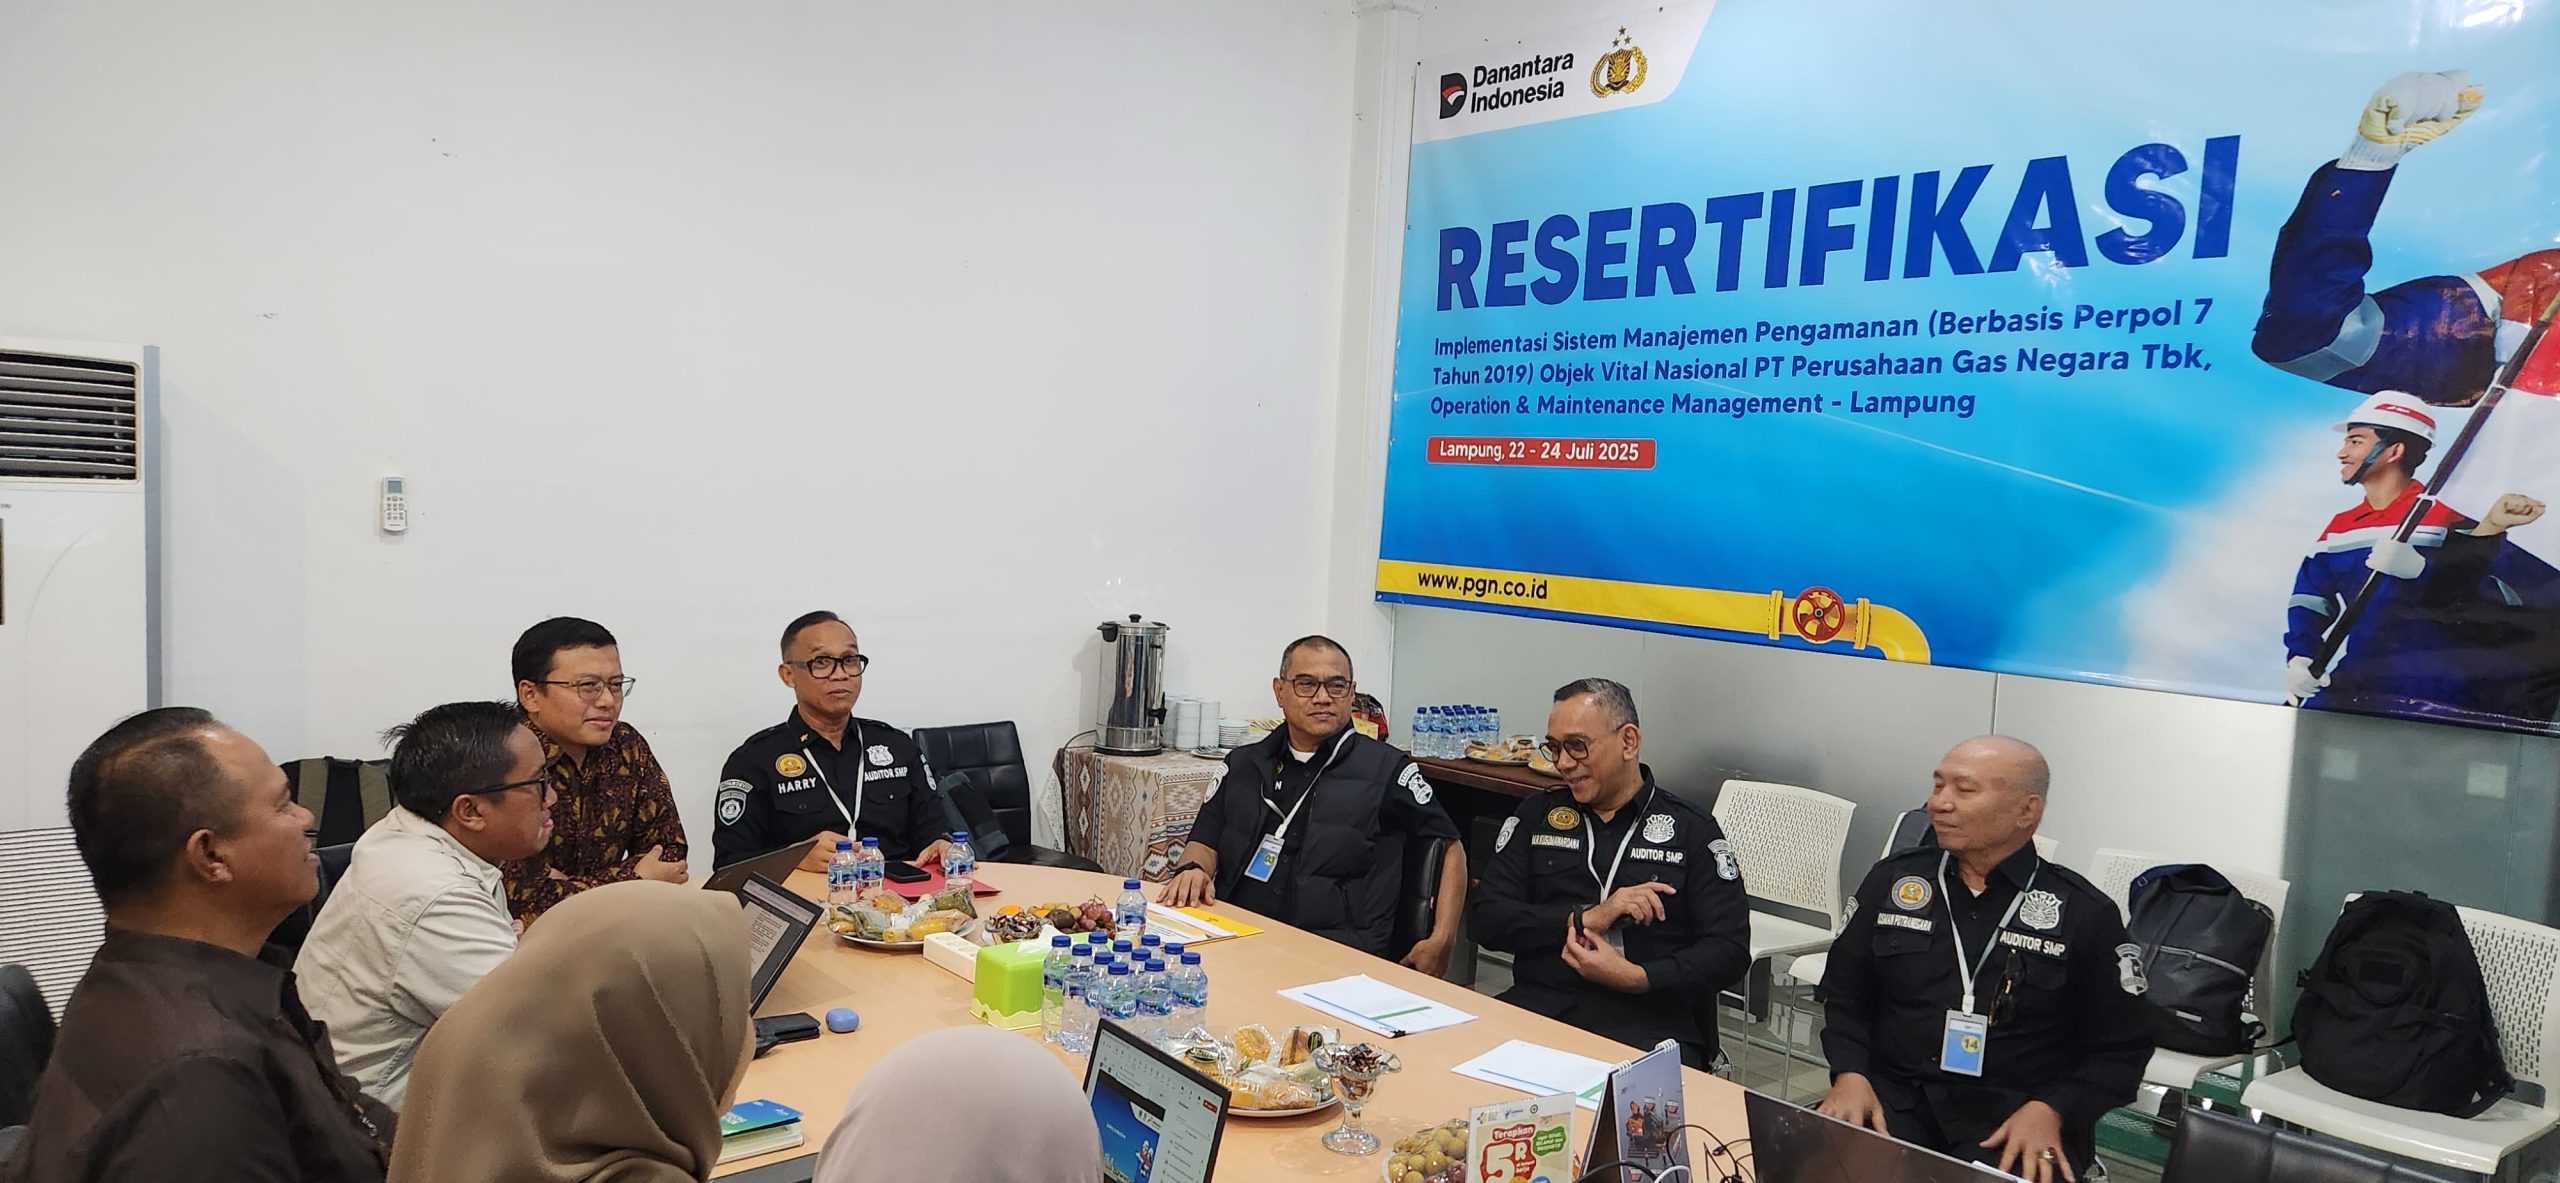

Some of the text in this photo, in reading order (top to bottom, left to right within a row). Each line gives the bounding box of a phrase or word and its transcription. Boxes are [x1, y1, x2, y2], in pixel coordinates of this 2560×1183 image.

[1473, 53, 1574, 89] Danantara
[1470, 80, 1564, 114] Indonesia
[1436, 134, 2241, 311] RESERTIFIKASI
[1434, 298, 2213, 358] Implementasi Sistem Manajemen Pengamanan (Berbasis Perpol 7
[1433, 342, 2213, 387] Tahun 2019) Objek Vital Nasional PT Perusahaan Gas Negara Tbk,
[1430, 396, 1511, 418] Operation
[1515, 395, 1530, 414] &
[1536, 394, 1665, 415] Maintenance
[1671, 392, 1824, 419] Management
[1850, 390, 1976, 419] Lampung
[1439, 440, 1506, 461] Lampung,
[1508, 441, 1526, 459] 22
[1540, 441, 1562, 460] 24
[1564, 442, 1595, 461] Juli
[1598, 442, 1640, 462] 2025
[1417, 571, 1548, 600] www.pgn.co.id
[777, 777, 817, 794] HARRY
[865, 766, 908, 782] AUDITOR SMP
[1264, 854, 1276, 864] 03
[1629, 847, 1684, 864] AUDITOR SMP
[2000, 930, 2066, 957] AUDITOR SMP
[1964, 1038, 1978, 1051] 14
[1493, 1127, 1533, 1139] Terapkan
